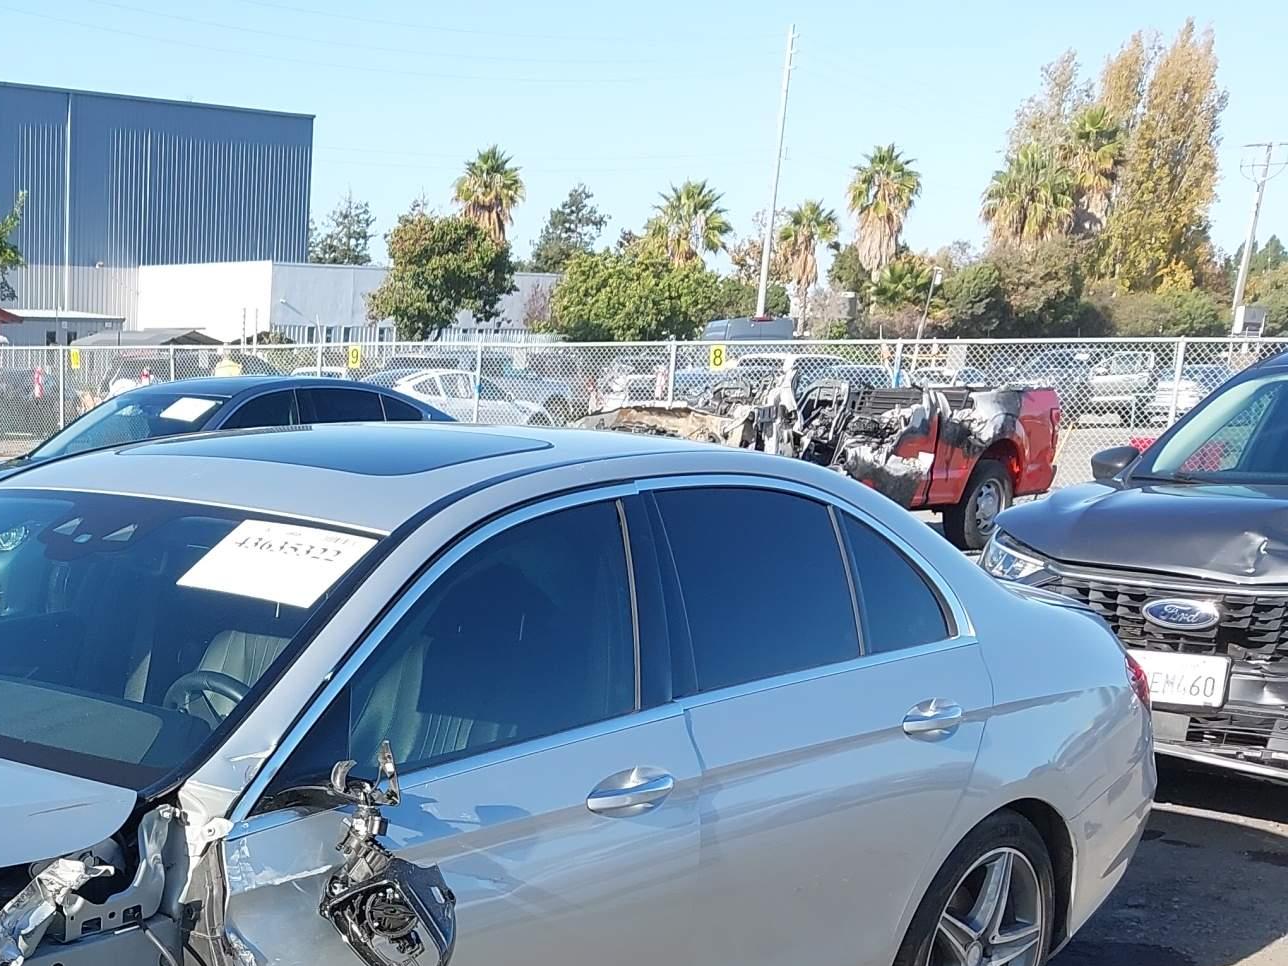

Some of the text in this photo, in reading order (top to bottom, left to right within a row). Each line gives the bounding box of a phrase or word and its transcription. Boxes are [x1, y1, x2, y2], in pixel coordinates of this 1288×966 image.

[351, 348, 359, 364] 9
[713, 348, 723, 366] 8
[233, 536, 343, 563] 43635322
[1160, 604, 1201, 622] Ford
